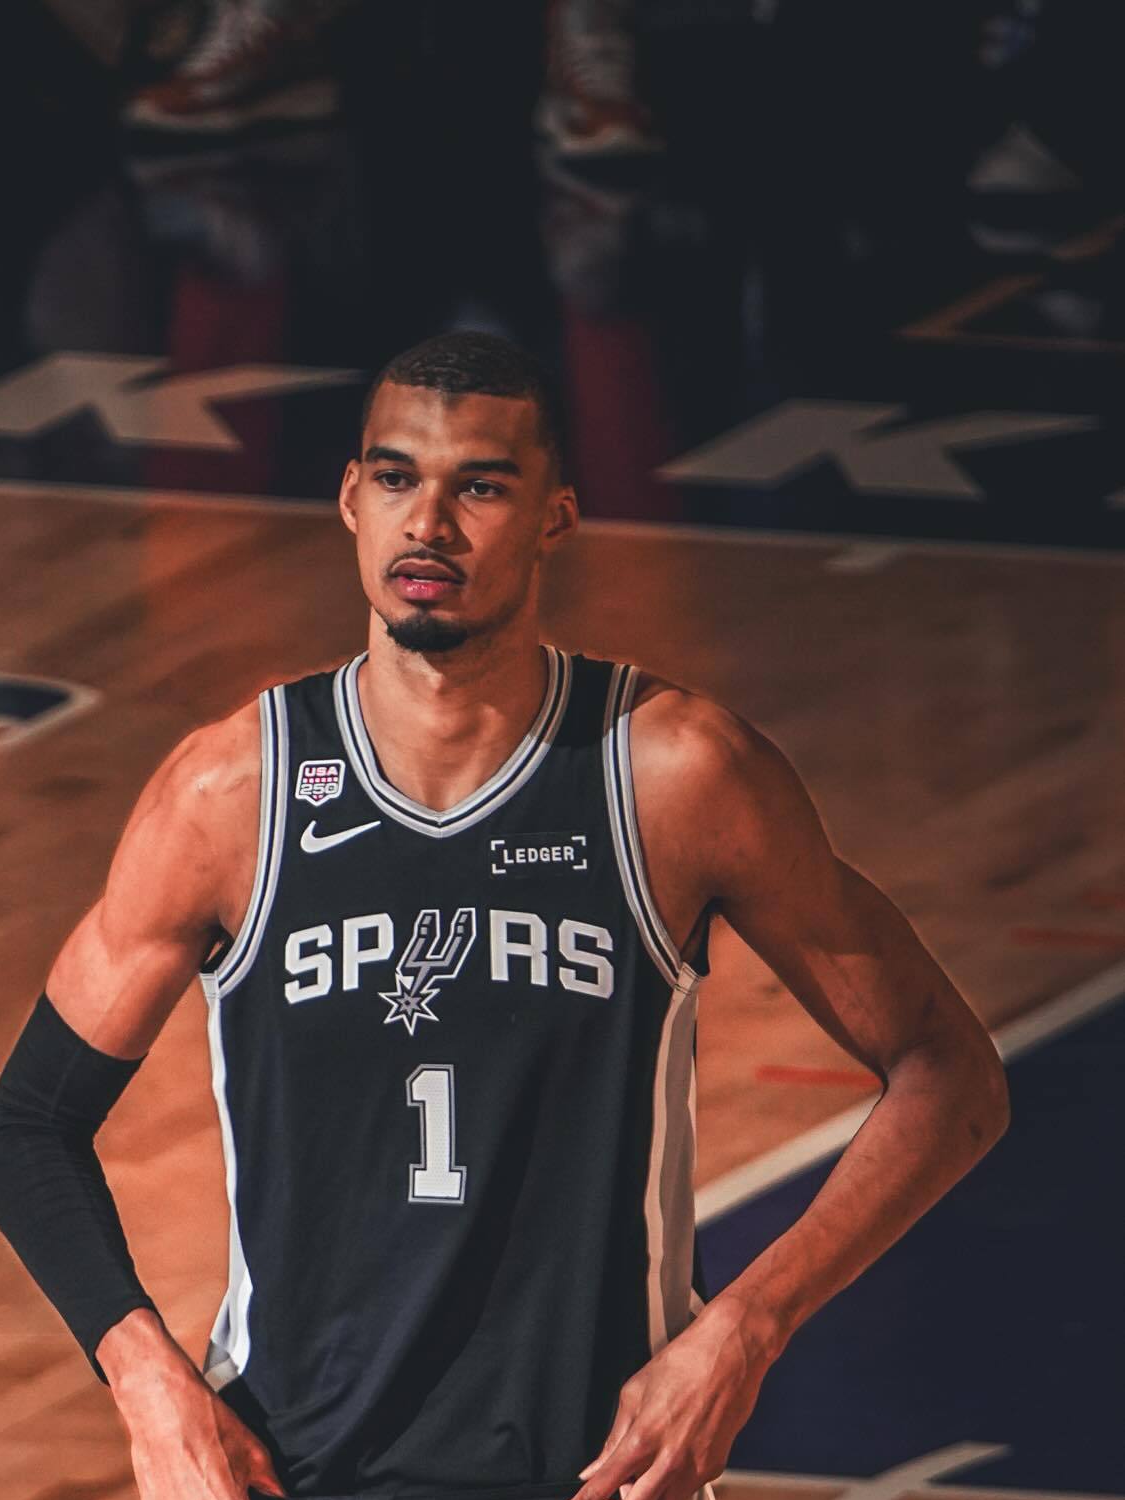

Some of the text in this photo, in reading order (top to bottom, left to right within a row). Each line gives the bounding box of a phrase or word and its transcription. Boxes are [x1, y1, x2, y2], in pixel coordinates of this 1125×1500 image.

[304, 766, 338, 777] USA
[299, 782, 339, 795] 250
[503, 846, 575, 864] LEDGER
[284, 907, 615, 1036] SPURS
[405, 1063, 468, 1204] 1
